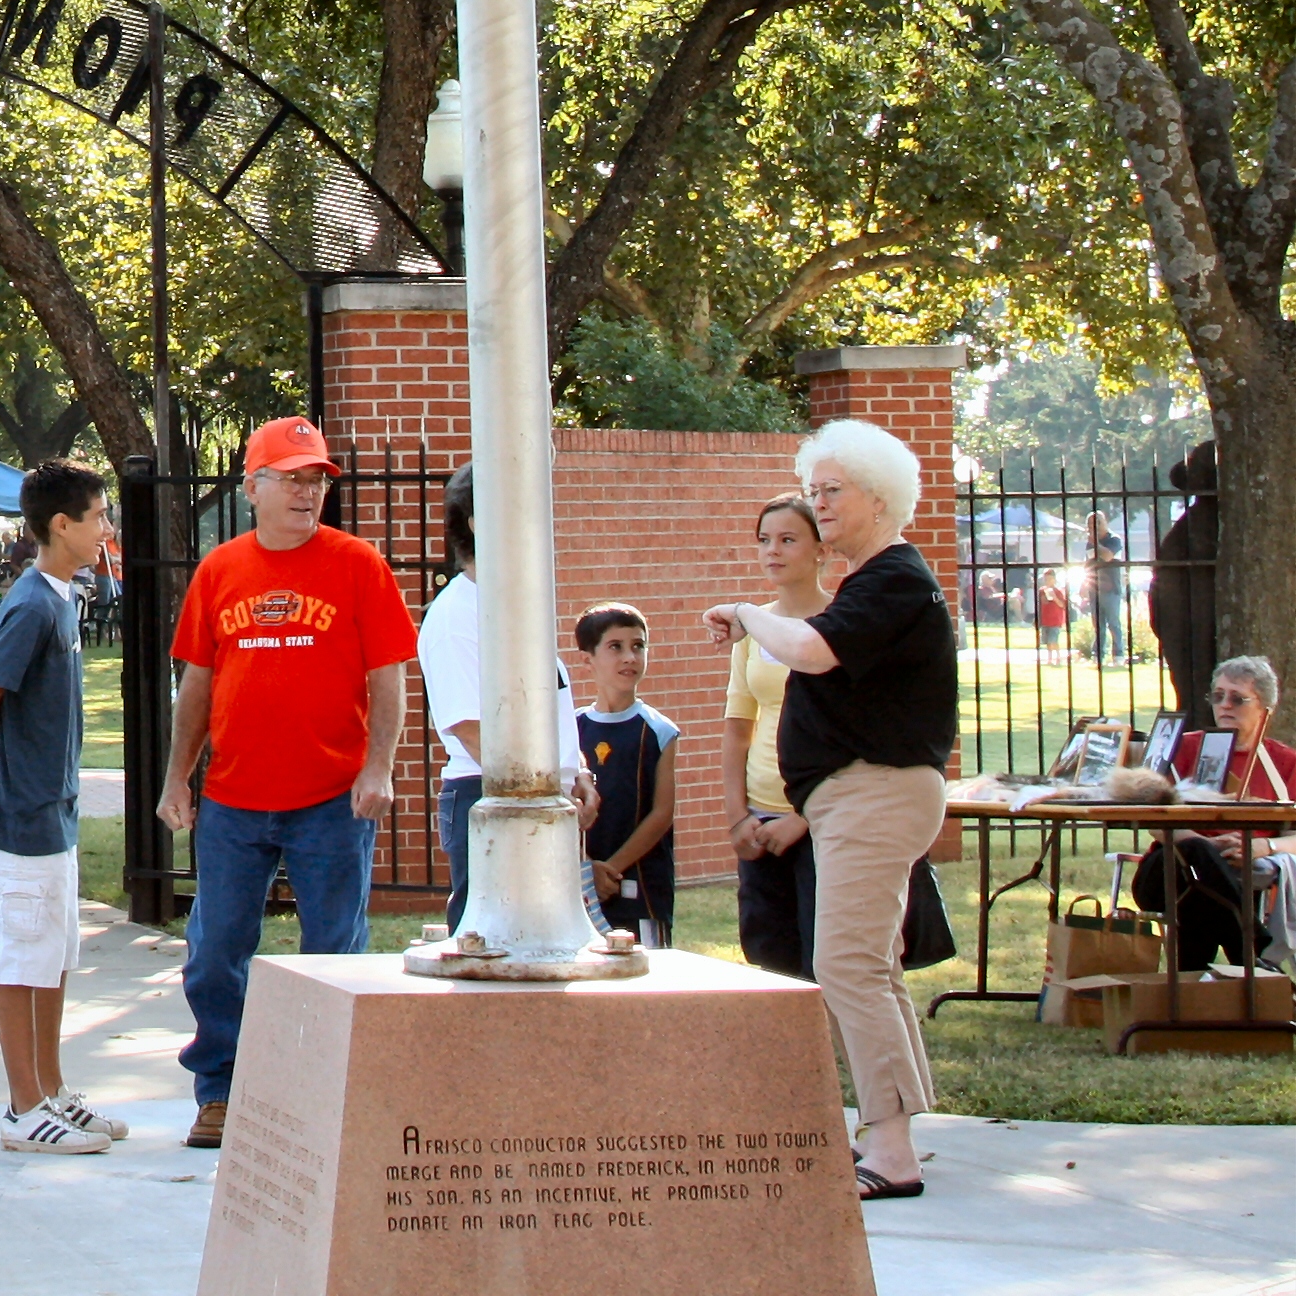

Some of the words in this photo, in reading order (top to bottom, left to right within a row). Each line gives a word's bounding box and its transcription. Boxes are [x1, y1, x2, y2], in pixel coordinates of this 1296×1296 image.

[219, 593, 337, 635] COOYS
[238, 637, 281, 649] OKLAHOMA
[285, 635, 314, 647] STATE
[402, 1125, 420, 1155] A
[425, 1139, 483, 1154] FRISCO
[490, 1137, 587, 1153] CONDUCTOR
[596, 1134, 688, 1151] SUGGESTED
[696, 1134, 725, 1150] THE
[735, 1133, 768, 1149] TWO
[774, 1132, 829, 1148] TOWNS
[386, 1165, 442, 1181] MERGE
[449, 1165, 483, 1180] AND
[494, 1164, 514, 1179] BE
[528, 1162, 586, 1178] NAMED
[597, 1160, 690, 1177] FREDERICK,
[698, 1159, 714, 1175] IN
[725, 1157, 780, 1174] HONOR
[795, 1157, 816, 1173] OF
[386, 1191, 412, 1206] HIS
[426, 1190, 464, 1205] SON.
[472, 1189, 492, 1204] AS
[501, 1188, 522, 1203] AN
[536, 1187, 622, 1203] INCENTIVE,
[631, 1186, 650, 1201] HE
[667, 1184, 749, 1201] PROMISED
[764, 1183, 783, 1199] TO
[387, 1215, 450, 1232] DONATE
[462, 1215, 483, 1230] AN
[499, 1213, 537, 1229] IRON
[553, 1213, 593, 1228] FLAG
[608, 1211, 653, 1227] POLE.
